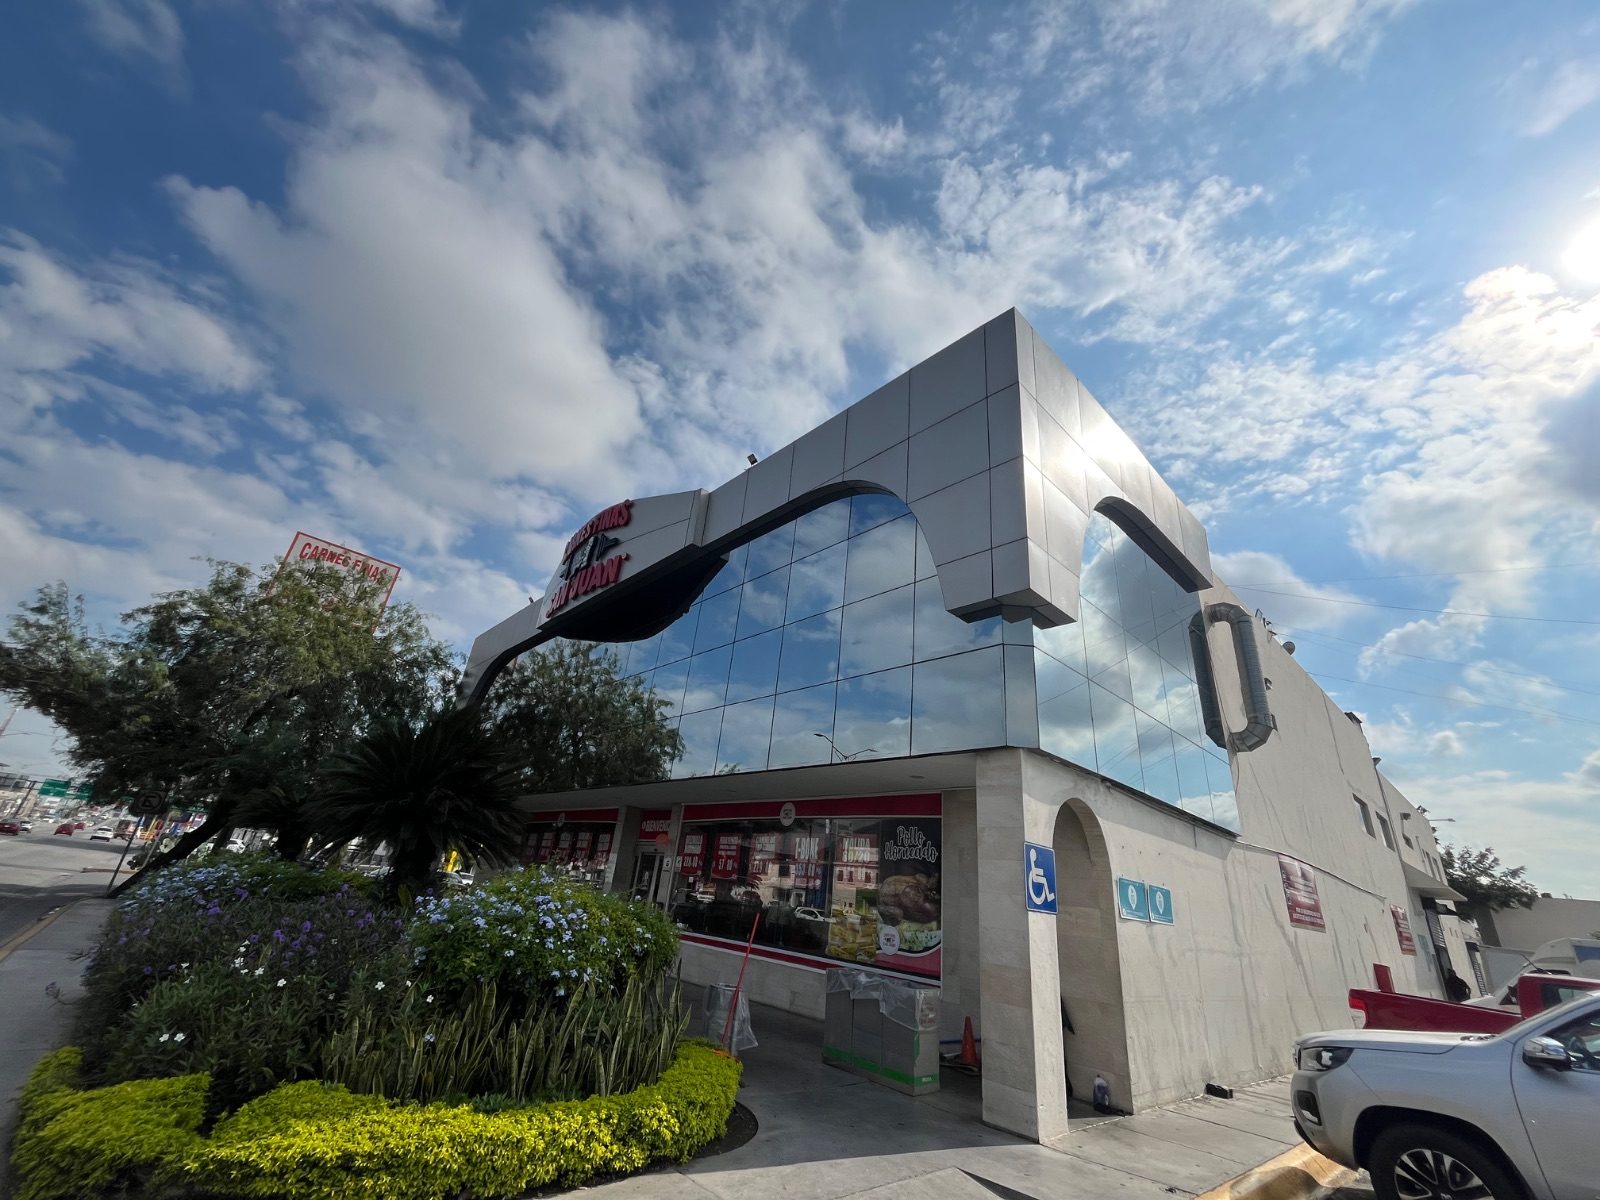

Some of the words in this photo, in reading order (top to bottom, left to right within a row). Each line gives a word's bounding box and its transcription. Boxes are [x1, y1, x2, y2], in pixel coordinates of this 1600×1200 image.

[298, 541, 352, 568] CARNES
[569, 555, 622, 601] JUAN
[896, 825, 925, 846] Pollo
[795, 838, 819, 860] T-BONE
[884, 839, 938, 863] Horneado
